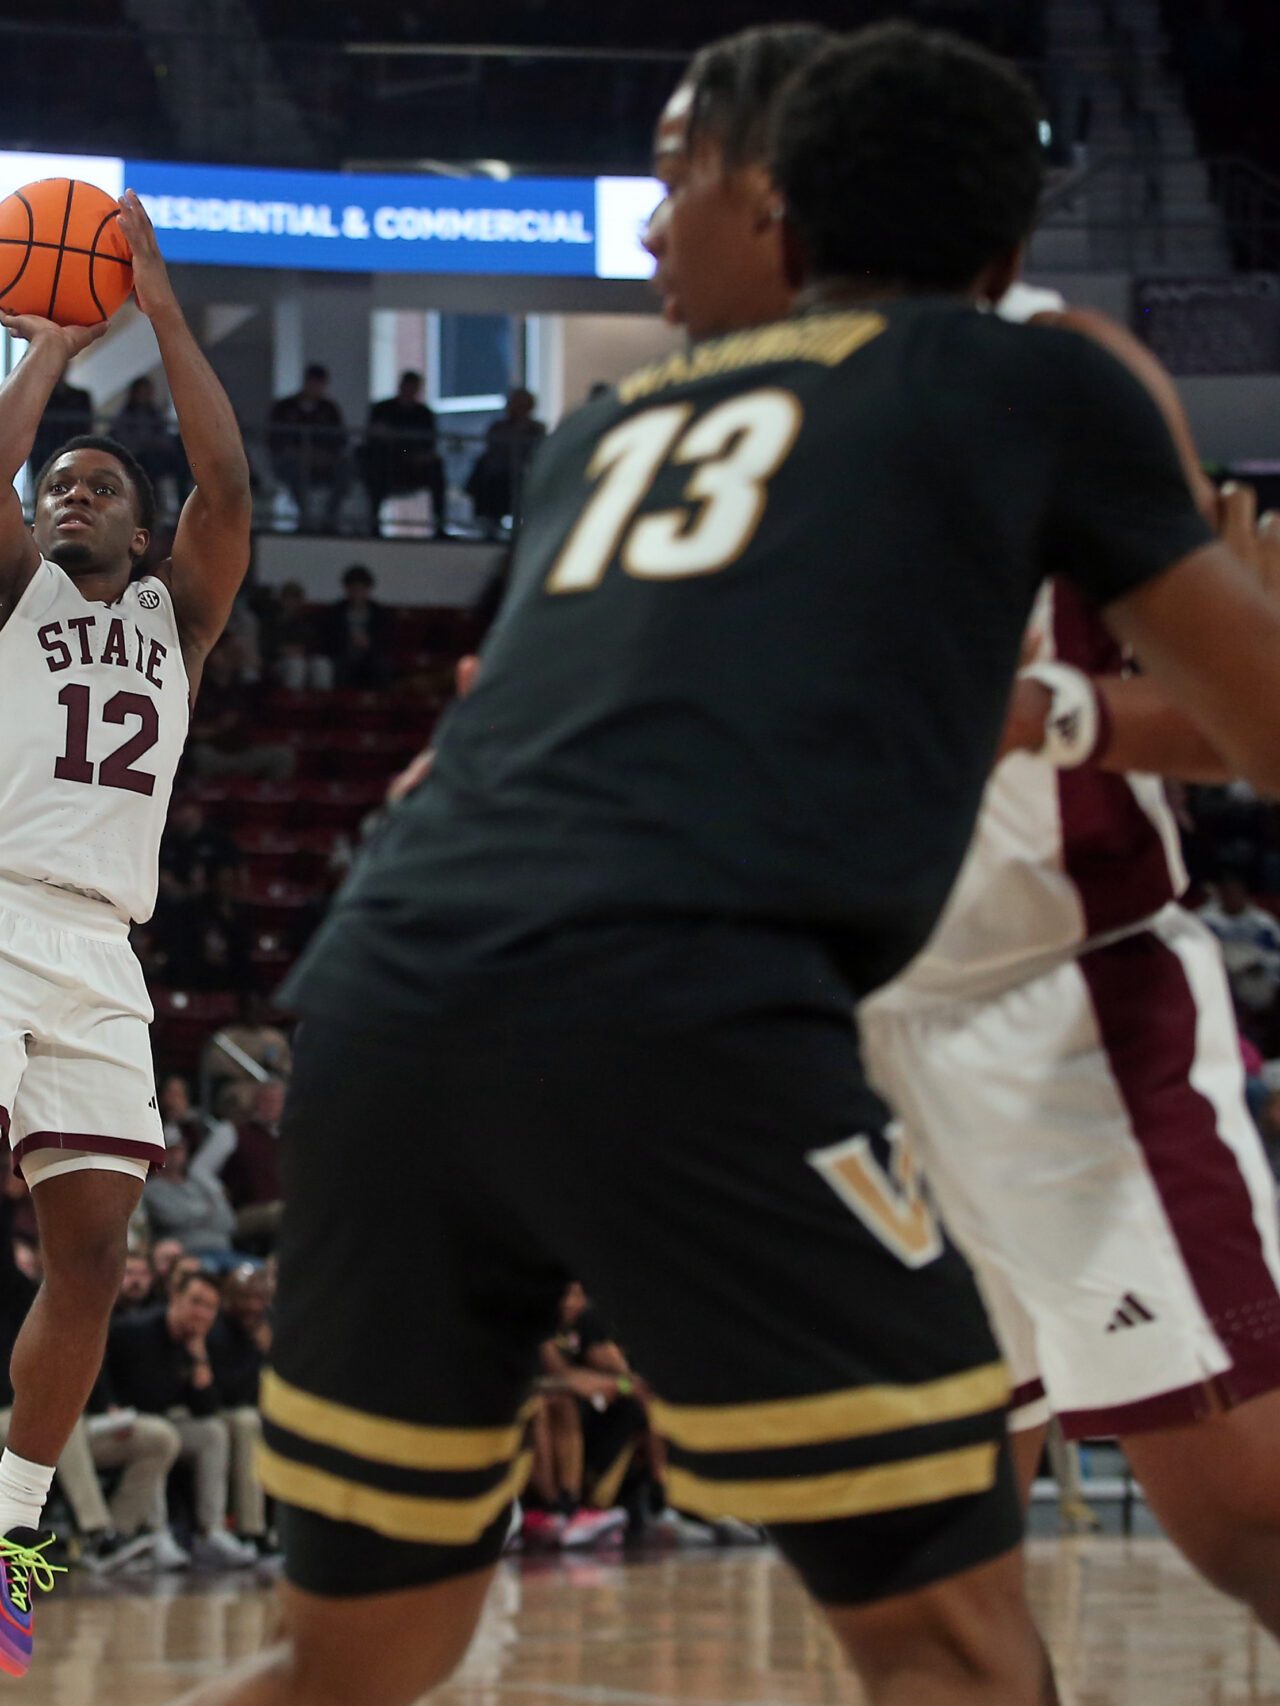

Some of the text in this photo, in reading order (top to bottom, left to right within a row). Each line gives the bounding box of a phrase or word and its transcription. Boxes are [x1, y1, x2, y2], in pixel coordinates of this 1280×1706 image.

[341, 206, 370, 240] &
[373, 206, 594, 245] COMMERCIAL
[546, 387, 804, 595] 13
[37, 615, 168, 691] STATE
[53, 682, 160, 797] 12
